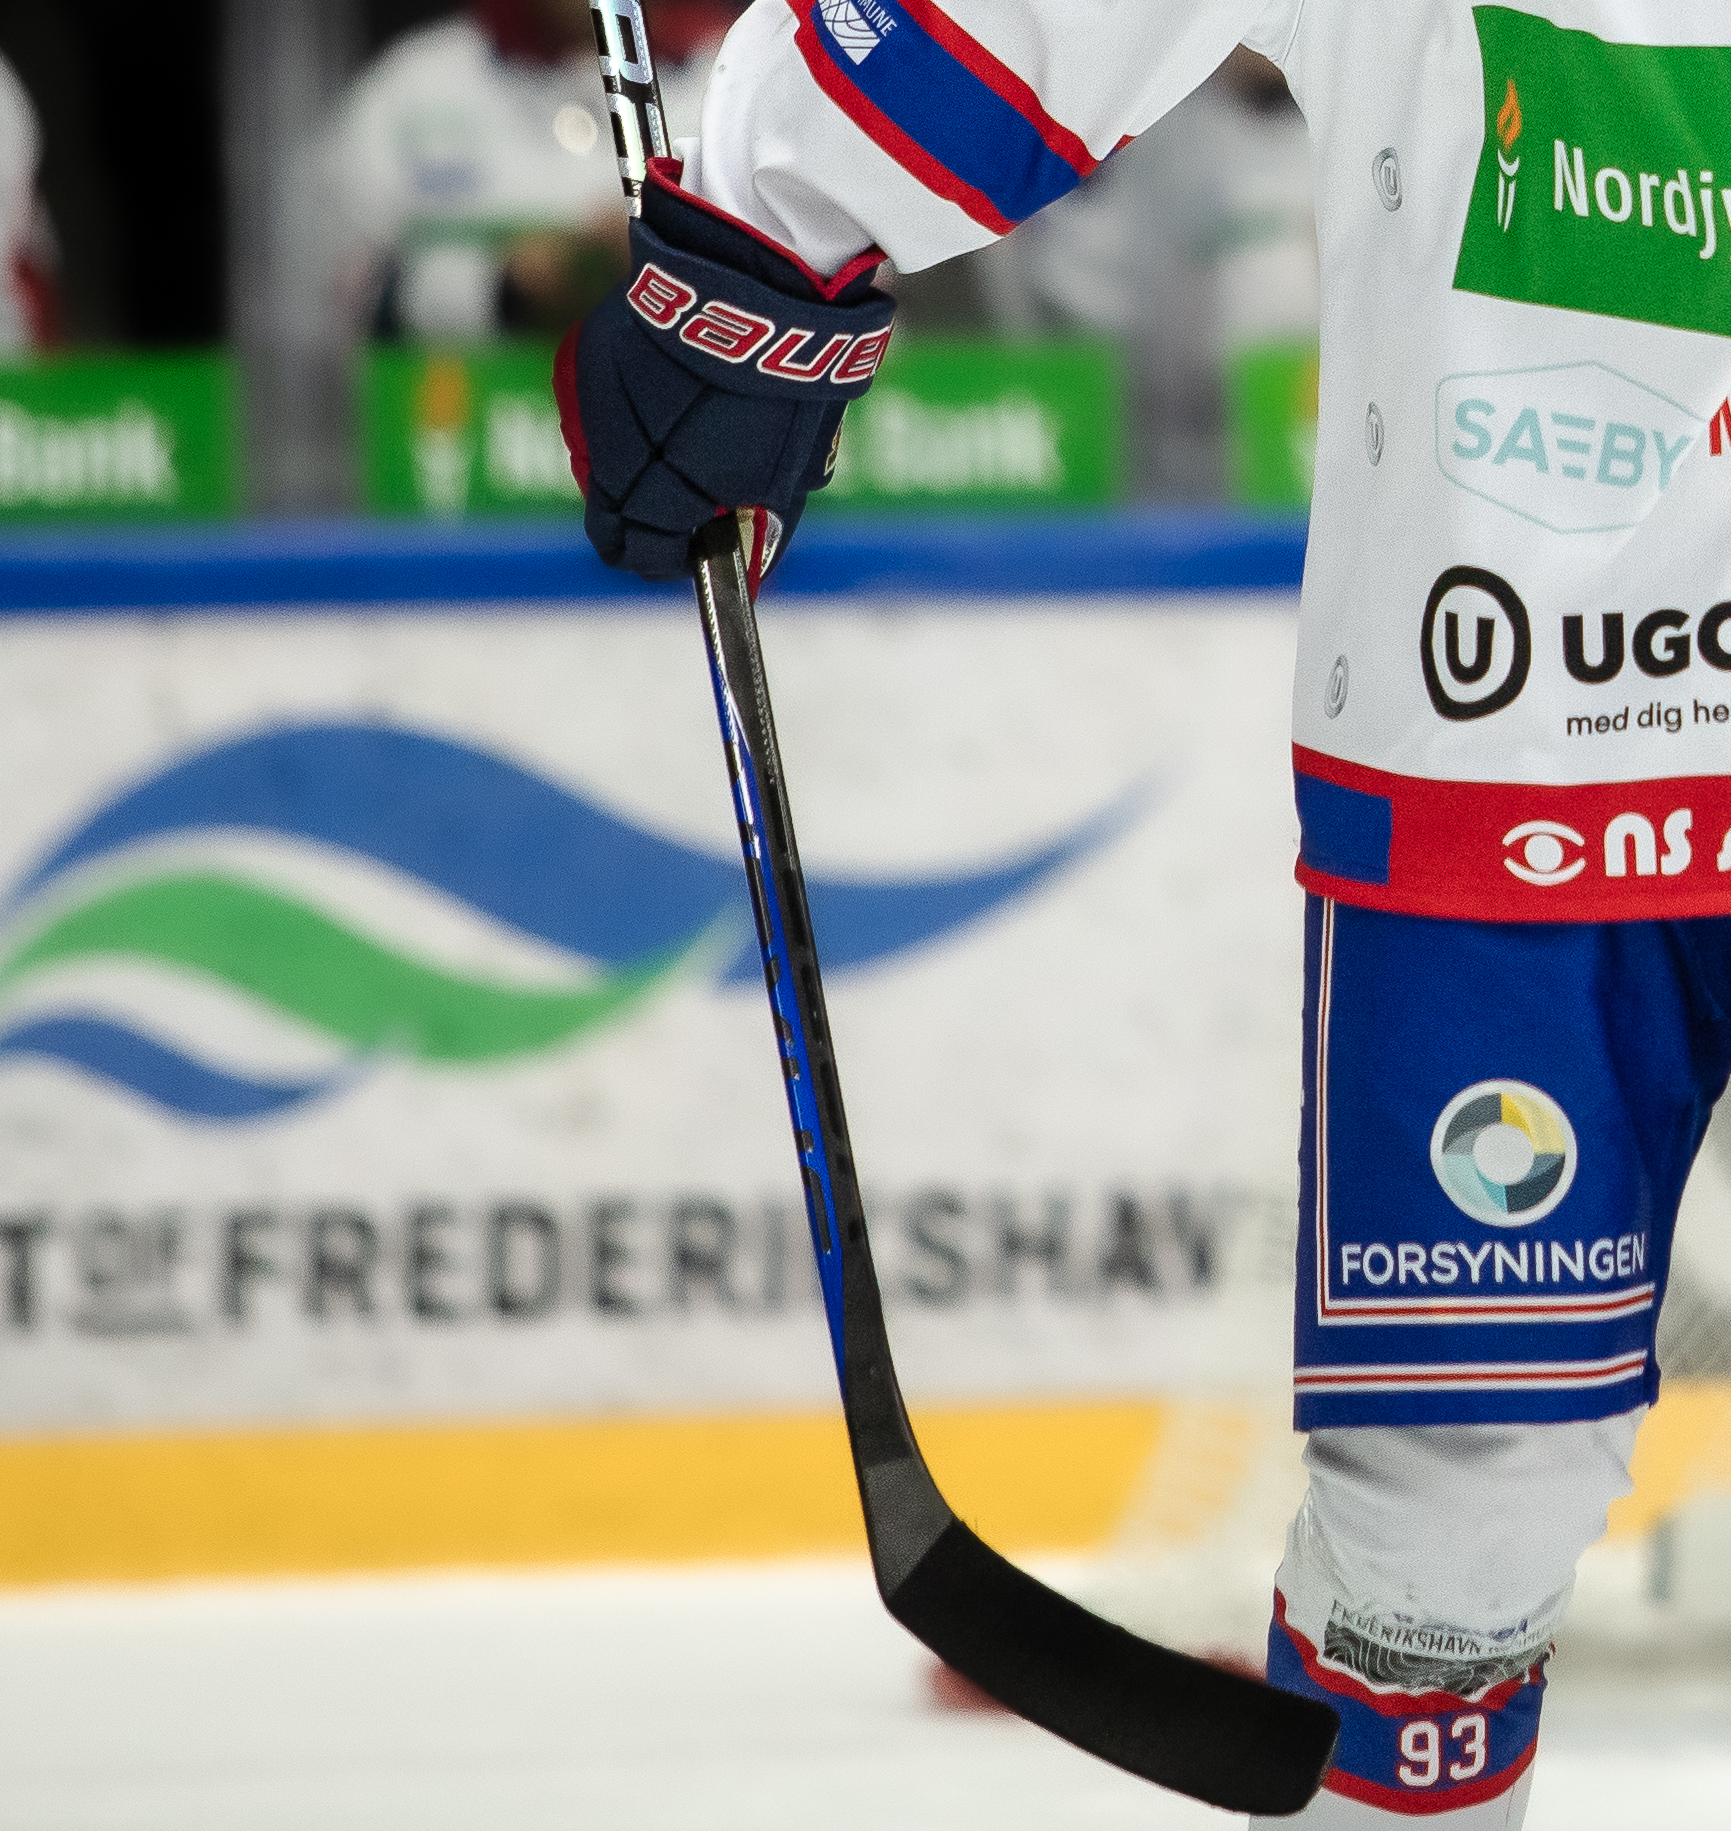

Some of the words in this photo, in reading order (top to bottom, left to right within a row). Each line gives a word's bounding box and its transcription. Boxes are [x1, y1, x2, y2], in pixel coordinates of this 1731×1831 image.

[626, 262, 894, 384] BAUE
[1566, 704, 1630, 738] med
[1636, 697, 1683, 733] dig
[1603, 807, 1693, 878] NS
[221, 1178, 1280, 1328] FREDERISHAV
[1340, 1230, 1645, 1286] FORSYNINGEN
[1399, 1713, 1487, 1787] 93
